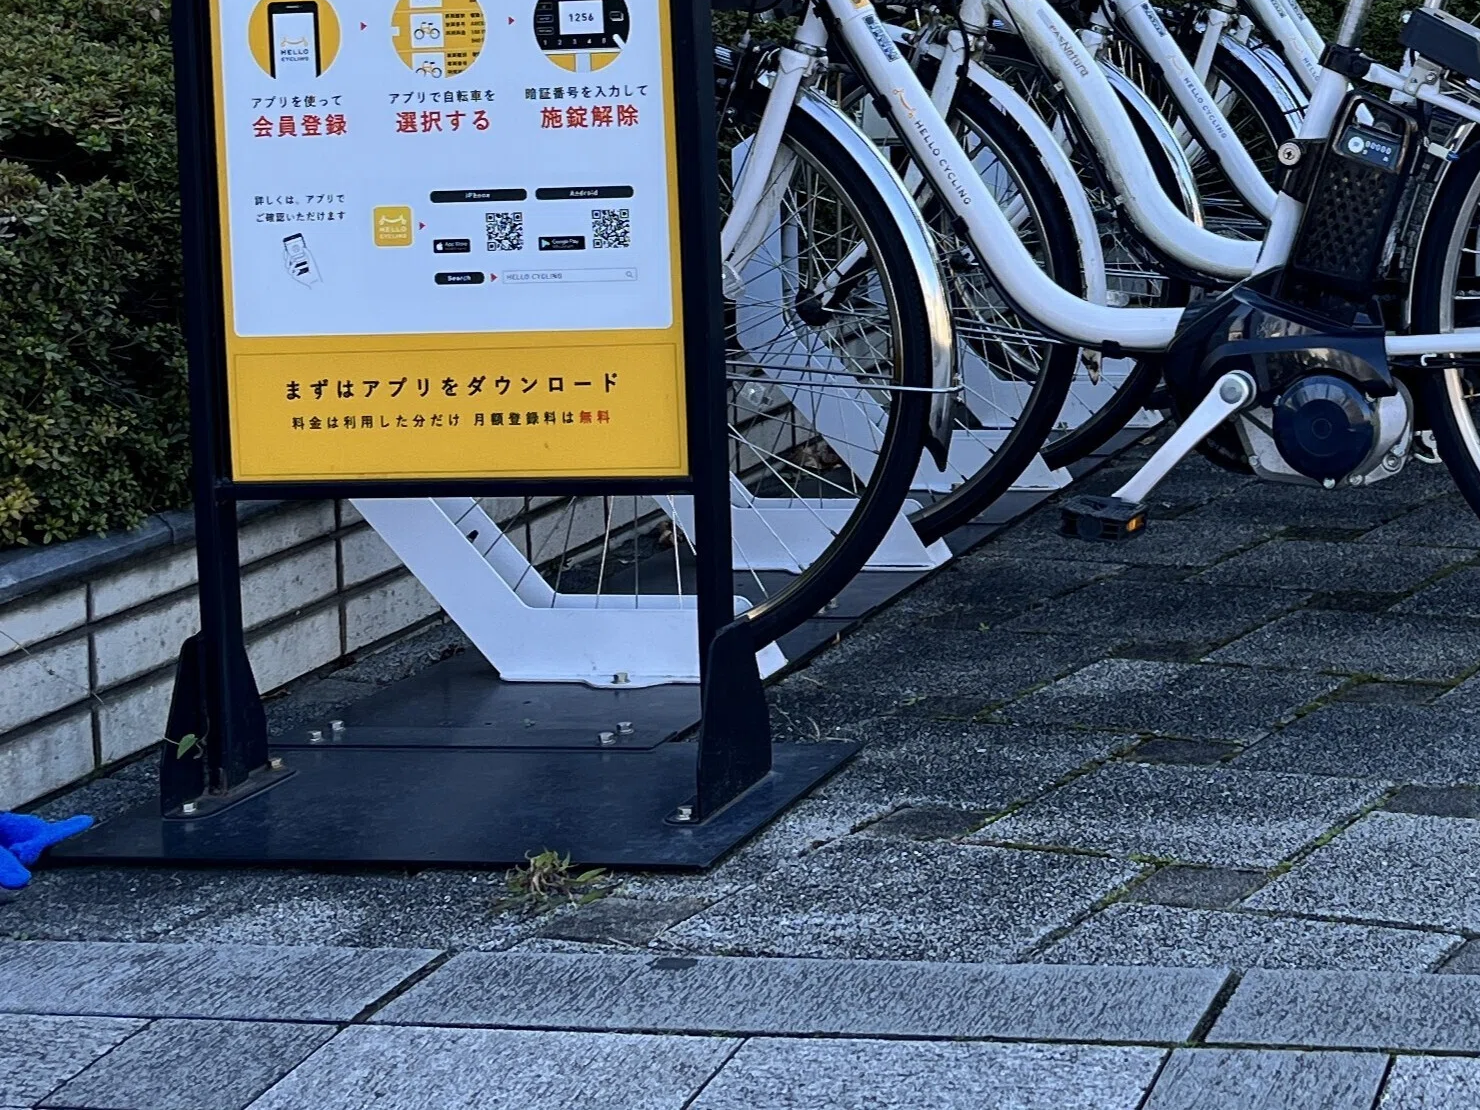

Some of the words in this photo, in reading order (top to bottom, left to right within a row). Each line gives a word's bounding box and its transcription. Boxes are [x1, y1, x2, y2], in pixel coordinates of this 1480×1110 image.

[568, 13, 594, 22] 1256
[251, 94, 343, 109] アプリを使って
[388, 89, 496, 104] アプリで自転車を
[524, 84, 649, 101] 暗証番号を入力して
[540, 104, 639, 129] 施錠解除
[1183, 77, 1203, 104] HELLO
[1202, 105, 1228, 139] CYCLING
[252, 113, 347, 138] 会員登録
[395, 109, 491, 133] 選択する
[914, 120, 941, 157] HELLO
[939, 158, 972, 206] CYCLING
[256, 211, 346, 222] ご確認いただけます
[286, 371, 620, 401] まずはアプリをダウンロード
[292, 413, 461, 430] 料金は利用した分だけ
[473, 409, 610, 426] 月額登録料は無料
